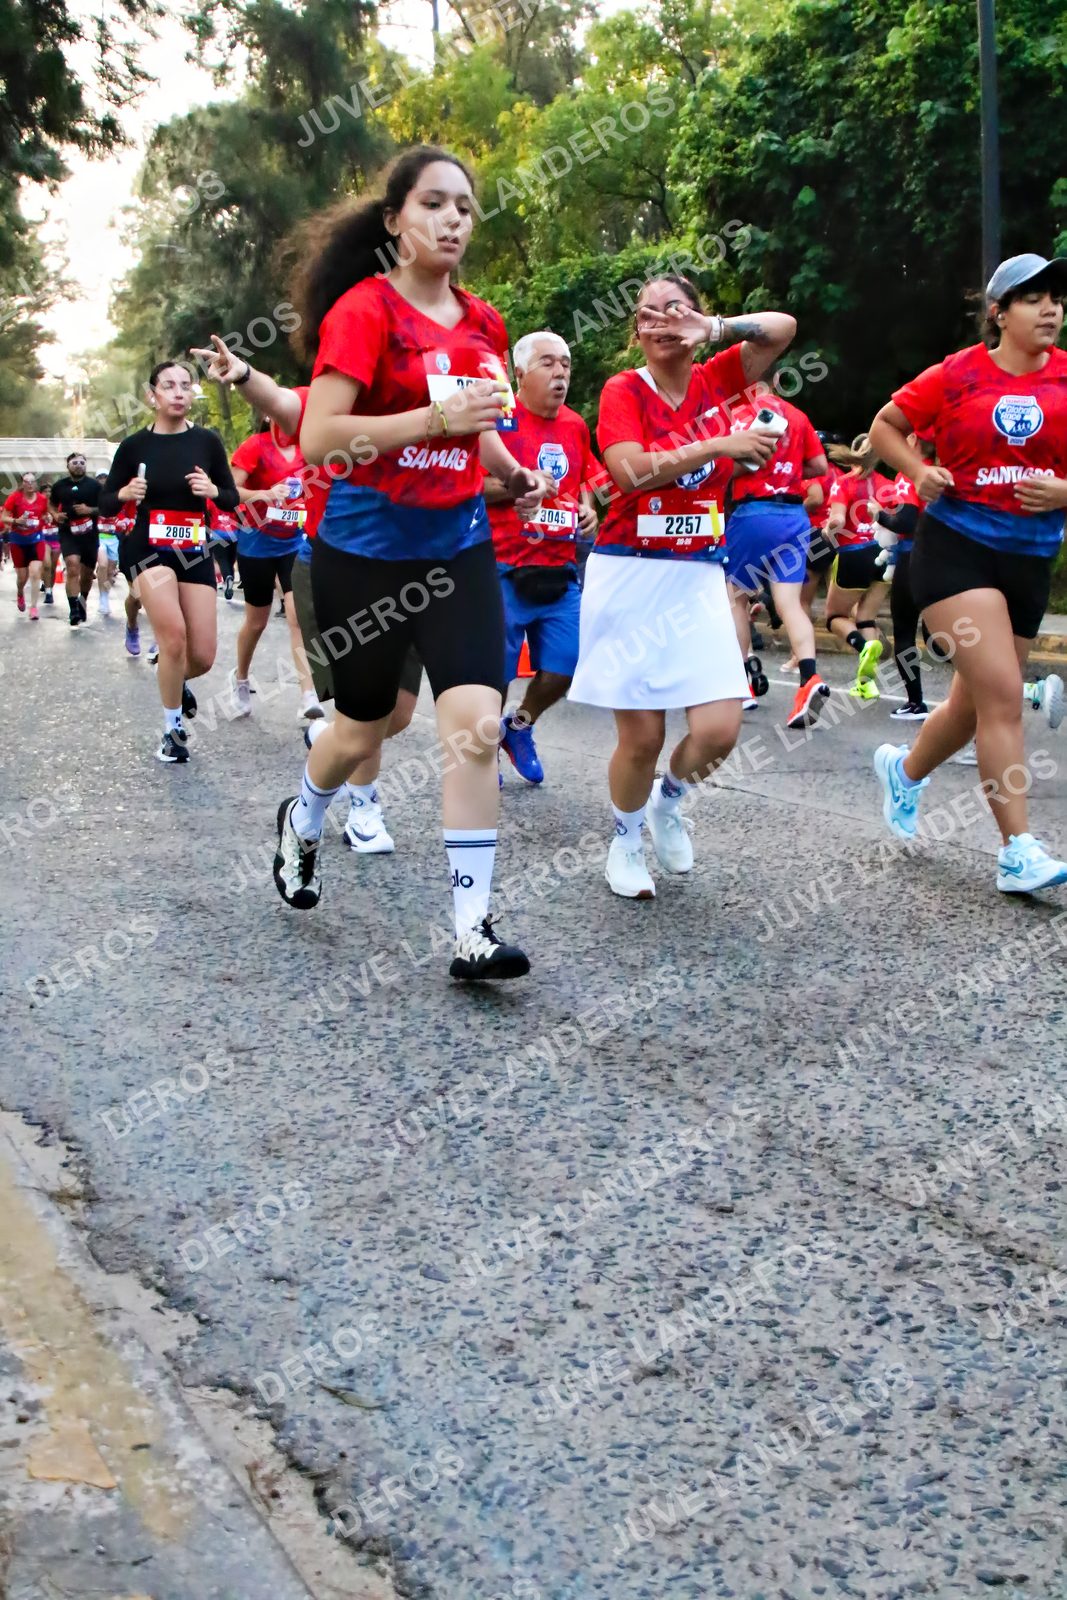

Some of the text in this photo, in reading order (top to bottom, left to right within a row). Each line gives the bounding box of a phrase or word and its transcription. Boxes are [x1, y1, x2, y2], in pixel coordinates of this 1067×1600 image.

[281, 510, 299, 521] 2310
[540, 510, 566, 524] 3045
[665, 516, 702, 535] 2257
[166, 526, 191, 539] 2805
